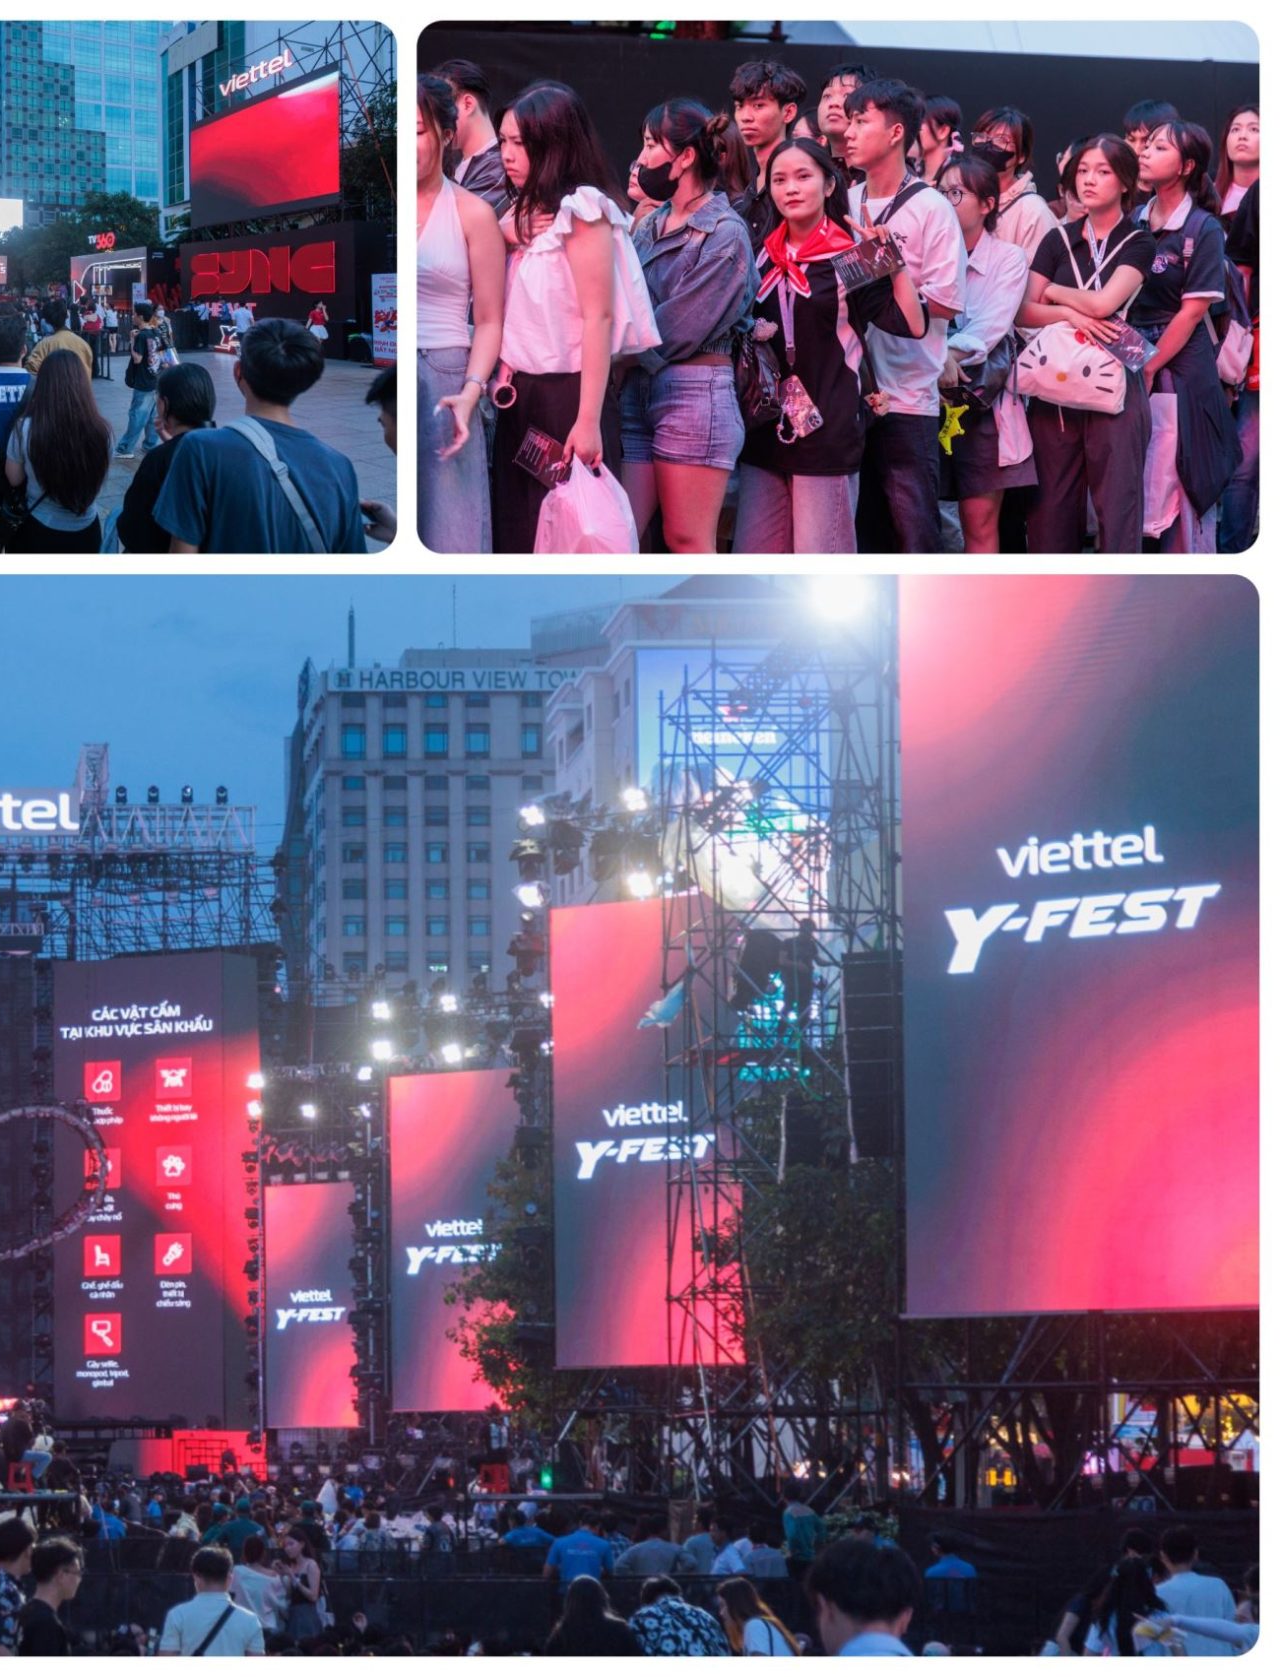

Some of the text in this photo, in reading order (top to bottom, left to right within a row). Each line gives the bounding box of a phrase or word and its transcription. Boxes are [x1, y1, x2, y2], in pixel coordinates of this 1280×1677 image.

[219, 49, 293, 97] viettel
[360, 671, 465, 689] HARBOUR
[472, 671, 528, 688] VIEW
[996, 824, 1165, 878] viettel
[944, 884, 1222, 974] Y-FEST
[91, 1000, 181, 1021] CÁC VẬT CẤM
[60, 1027, 82, 1040] TẠI
[84, 1025, 113, 1038] KHU
[144, 1019, 173, 1034] SÂN
[602, 1100, 689, 1127] viettel
[575, 1133, 716, 1180] Y-FEST
[425, 1218, 483, 1237] viettel
[290, 1289, 333, 1303] viettel
[276, 1306, 346, 1330] Y-FEST
